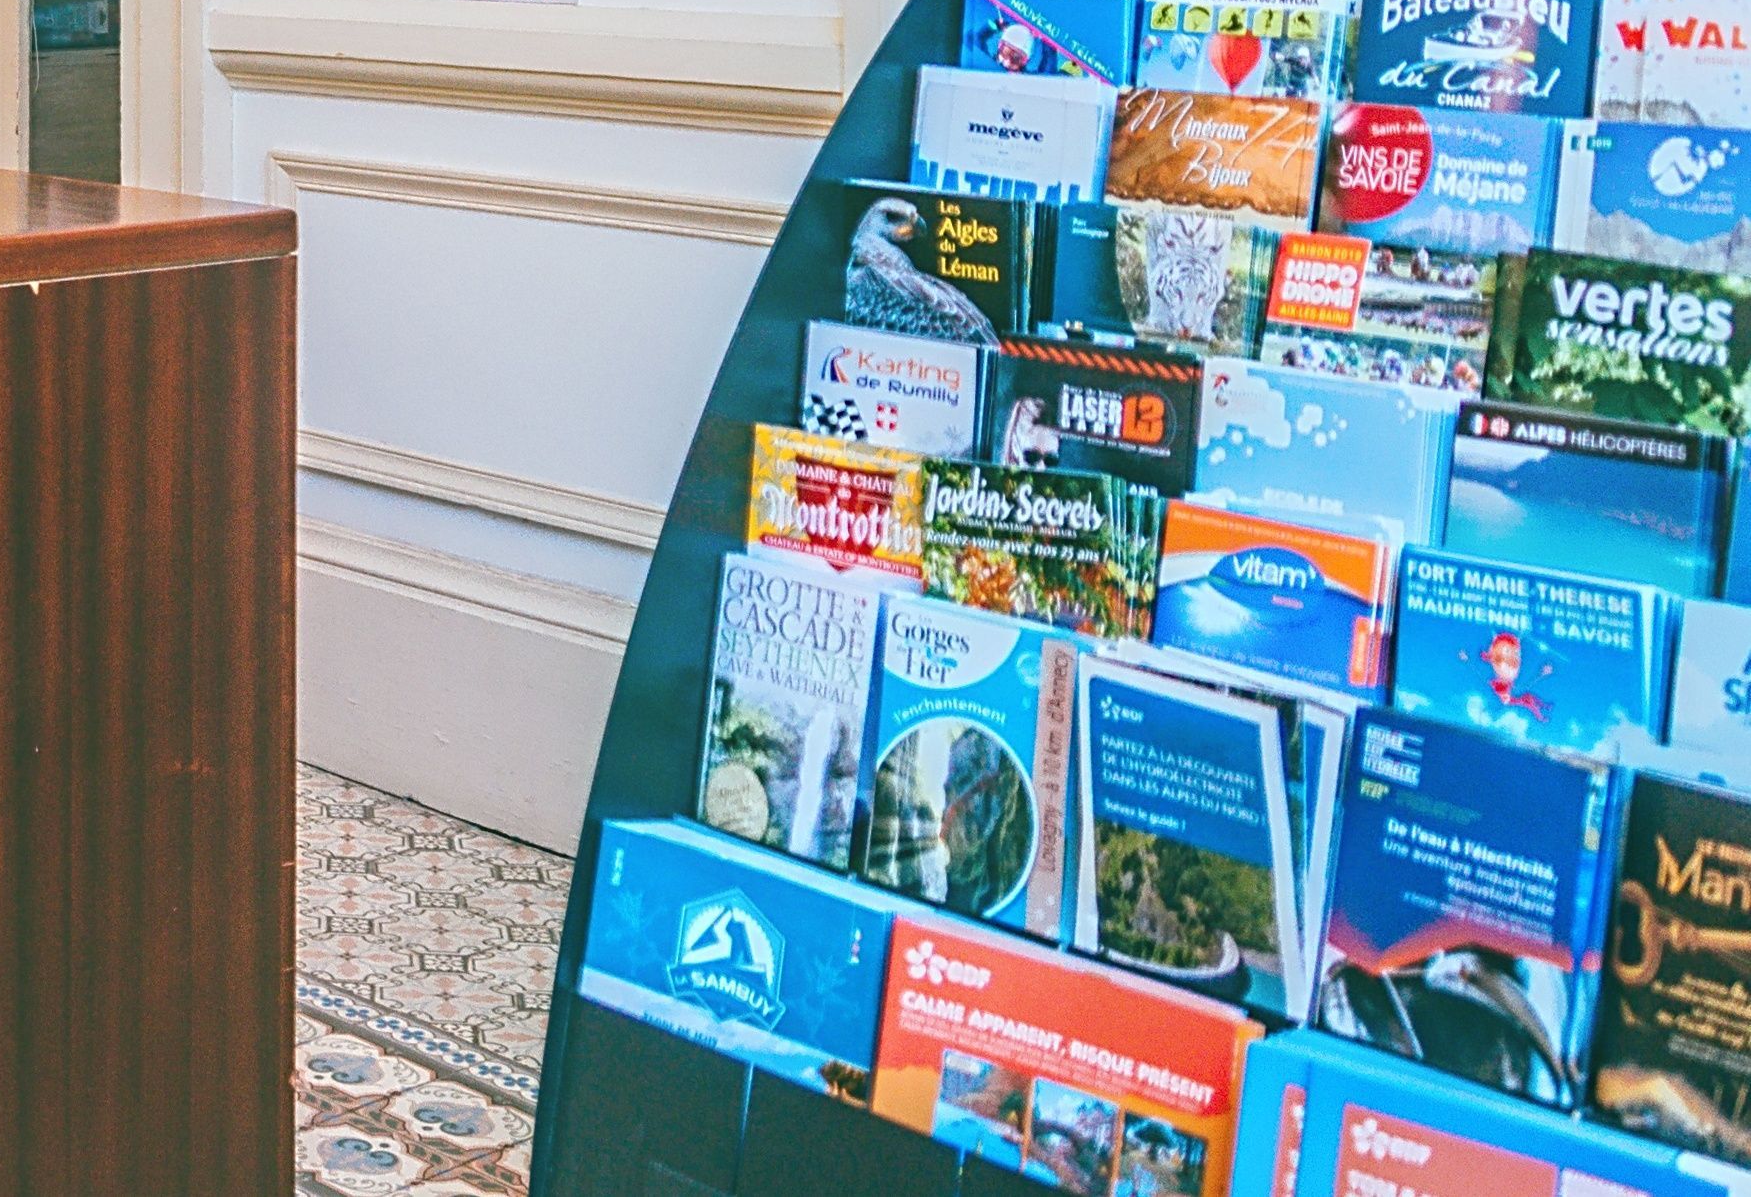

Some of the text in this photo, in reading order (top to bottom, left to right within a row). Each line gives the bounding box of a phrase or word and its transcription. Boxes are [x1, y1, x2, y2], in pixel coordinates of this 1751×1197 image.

[1379, 61, 1561, 98] du Canal
[968, 120, 1045, 143] megève
[1182, 139, 1252, 190] Bijoux
[1340, 144, 1423, 175] VINS DE
[1437, 153, 1528, 178] Domaine de
[1338, 164, 1418, 196] SAVOIE
[1433, 171, 1527, 205] Méjane
[940, 200, 961, 216] Les
[938, 217, 998, 247] Aigles
[939, 239, 956, 253] du
[940, 256, 1000, 282] Léman
[1285, 258, 1358, 289] HIPPO
[1551, 274, 1734, 342] vertes
[857, 351, 961, 392] Karting
[856, 374, 960, 407] de Rumilly
[1061, 392, 1123, 425] LASER
[1514, 422, 1567, 445] ALPES
[925, 466, 1015, 523] Jardins
[1016, 482, 1107, 532] Secrets
[762, 483, 923, 555] Montrottier
[1003, 539, 1031, 554] avec
[1035, 543, 1057, 558] nos
[1077, 548, 1099, 563] ans
[1407, 559, 1458, 586] FORT
[727, 566, 845, 622] GROTTE
[723, 596, 865, 663] CASCADE
[892, 612, 971, 654] Gorges
[1407, 595, 1532, 632] MAURIENNE
[1553, 620, 1634, 651] SAVOIE
[717, 653, 751, 677] CAVE
[903, 648, 952, 685] Fier
[1101, 734, 1146, 755] PARTEZ
[1102, 769, 1137, 789] DANS
[1386, 817, 1408, 838] De
[691, 970, 776, 1017] SAMBUY
[900, 989, 965, 1023] CALME
[1070, 1040, 1135, 1076] RISQUE
